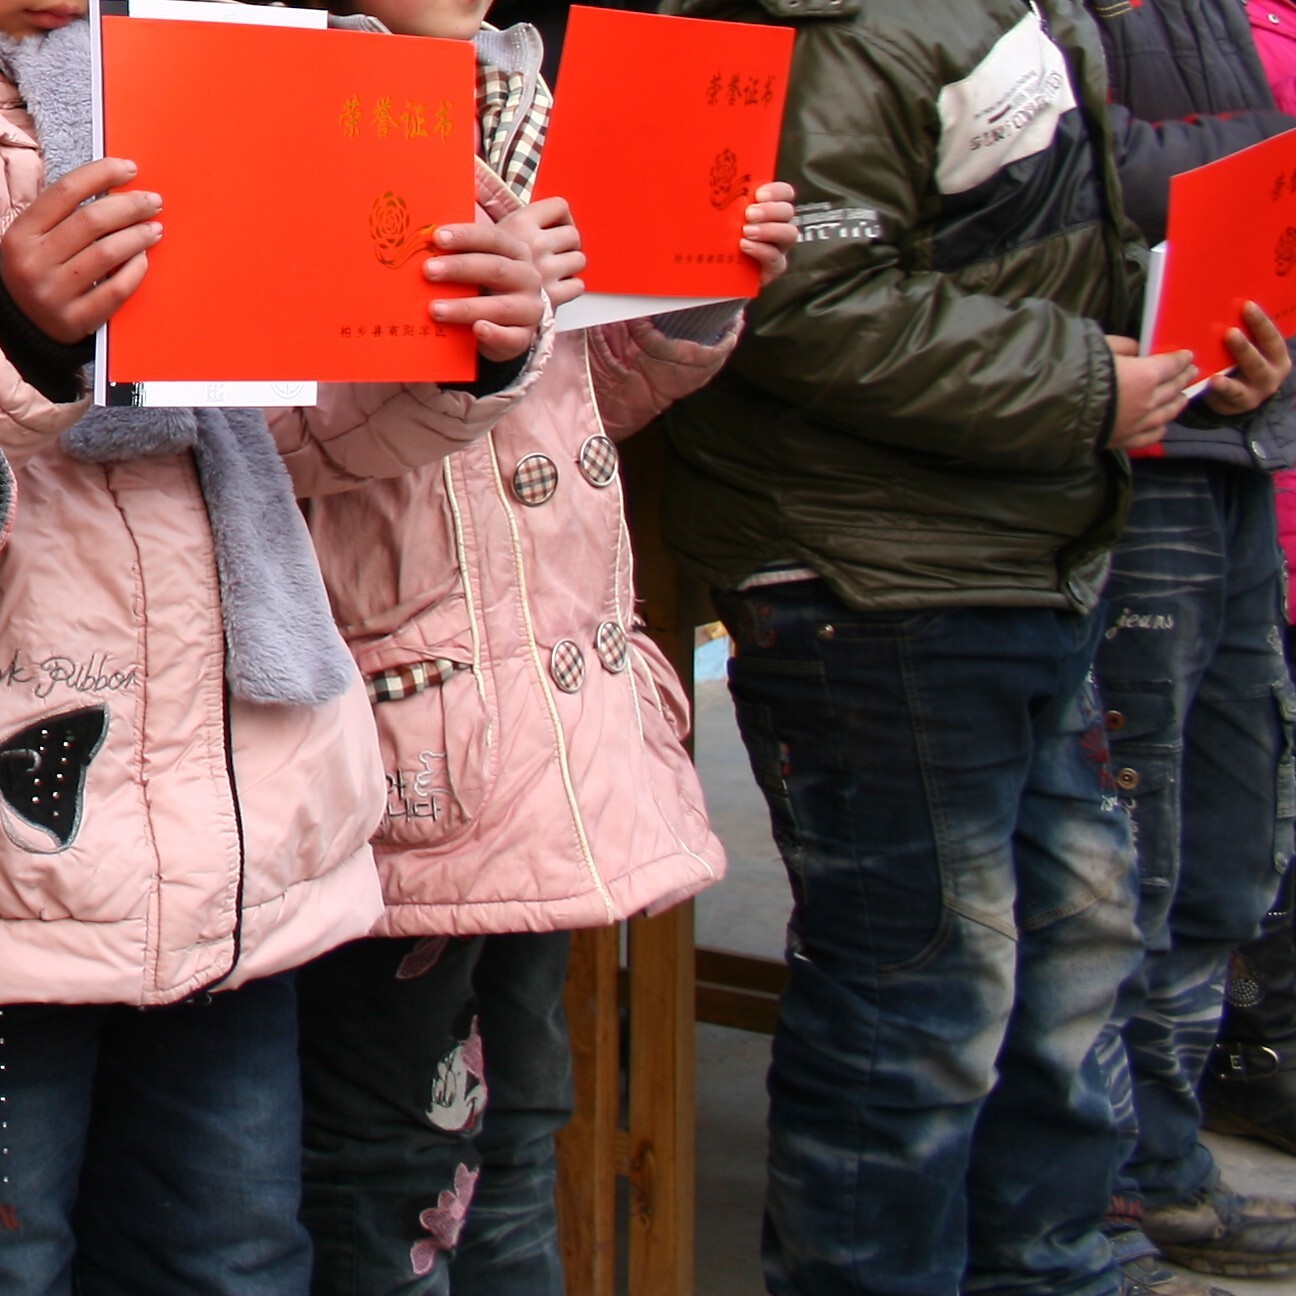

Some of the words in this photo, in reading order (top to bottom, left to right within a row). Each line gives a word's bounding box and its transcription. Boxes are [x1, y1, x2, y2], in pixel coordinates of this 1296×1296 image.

[705, 71, 776, 109] 荣誉证书
[338, 92, 455, 144] 荣誉证书
[34, 648, 142, 699] Ribbon
